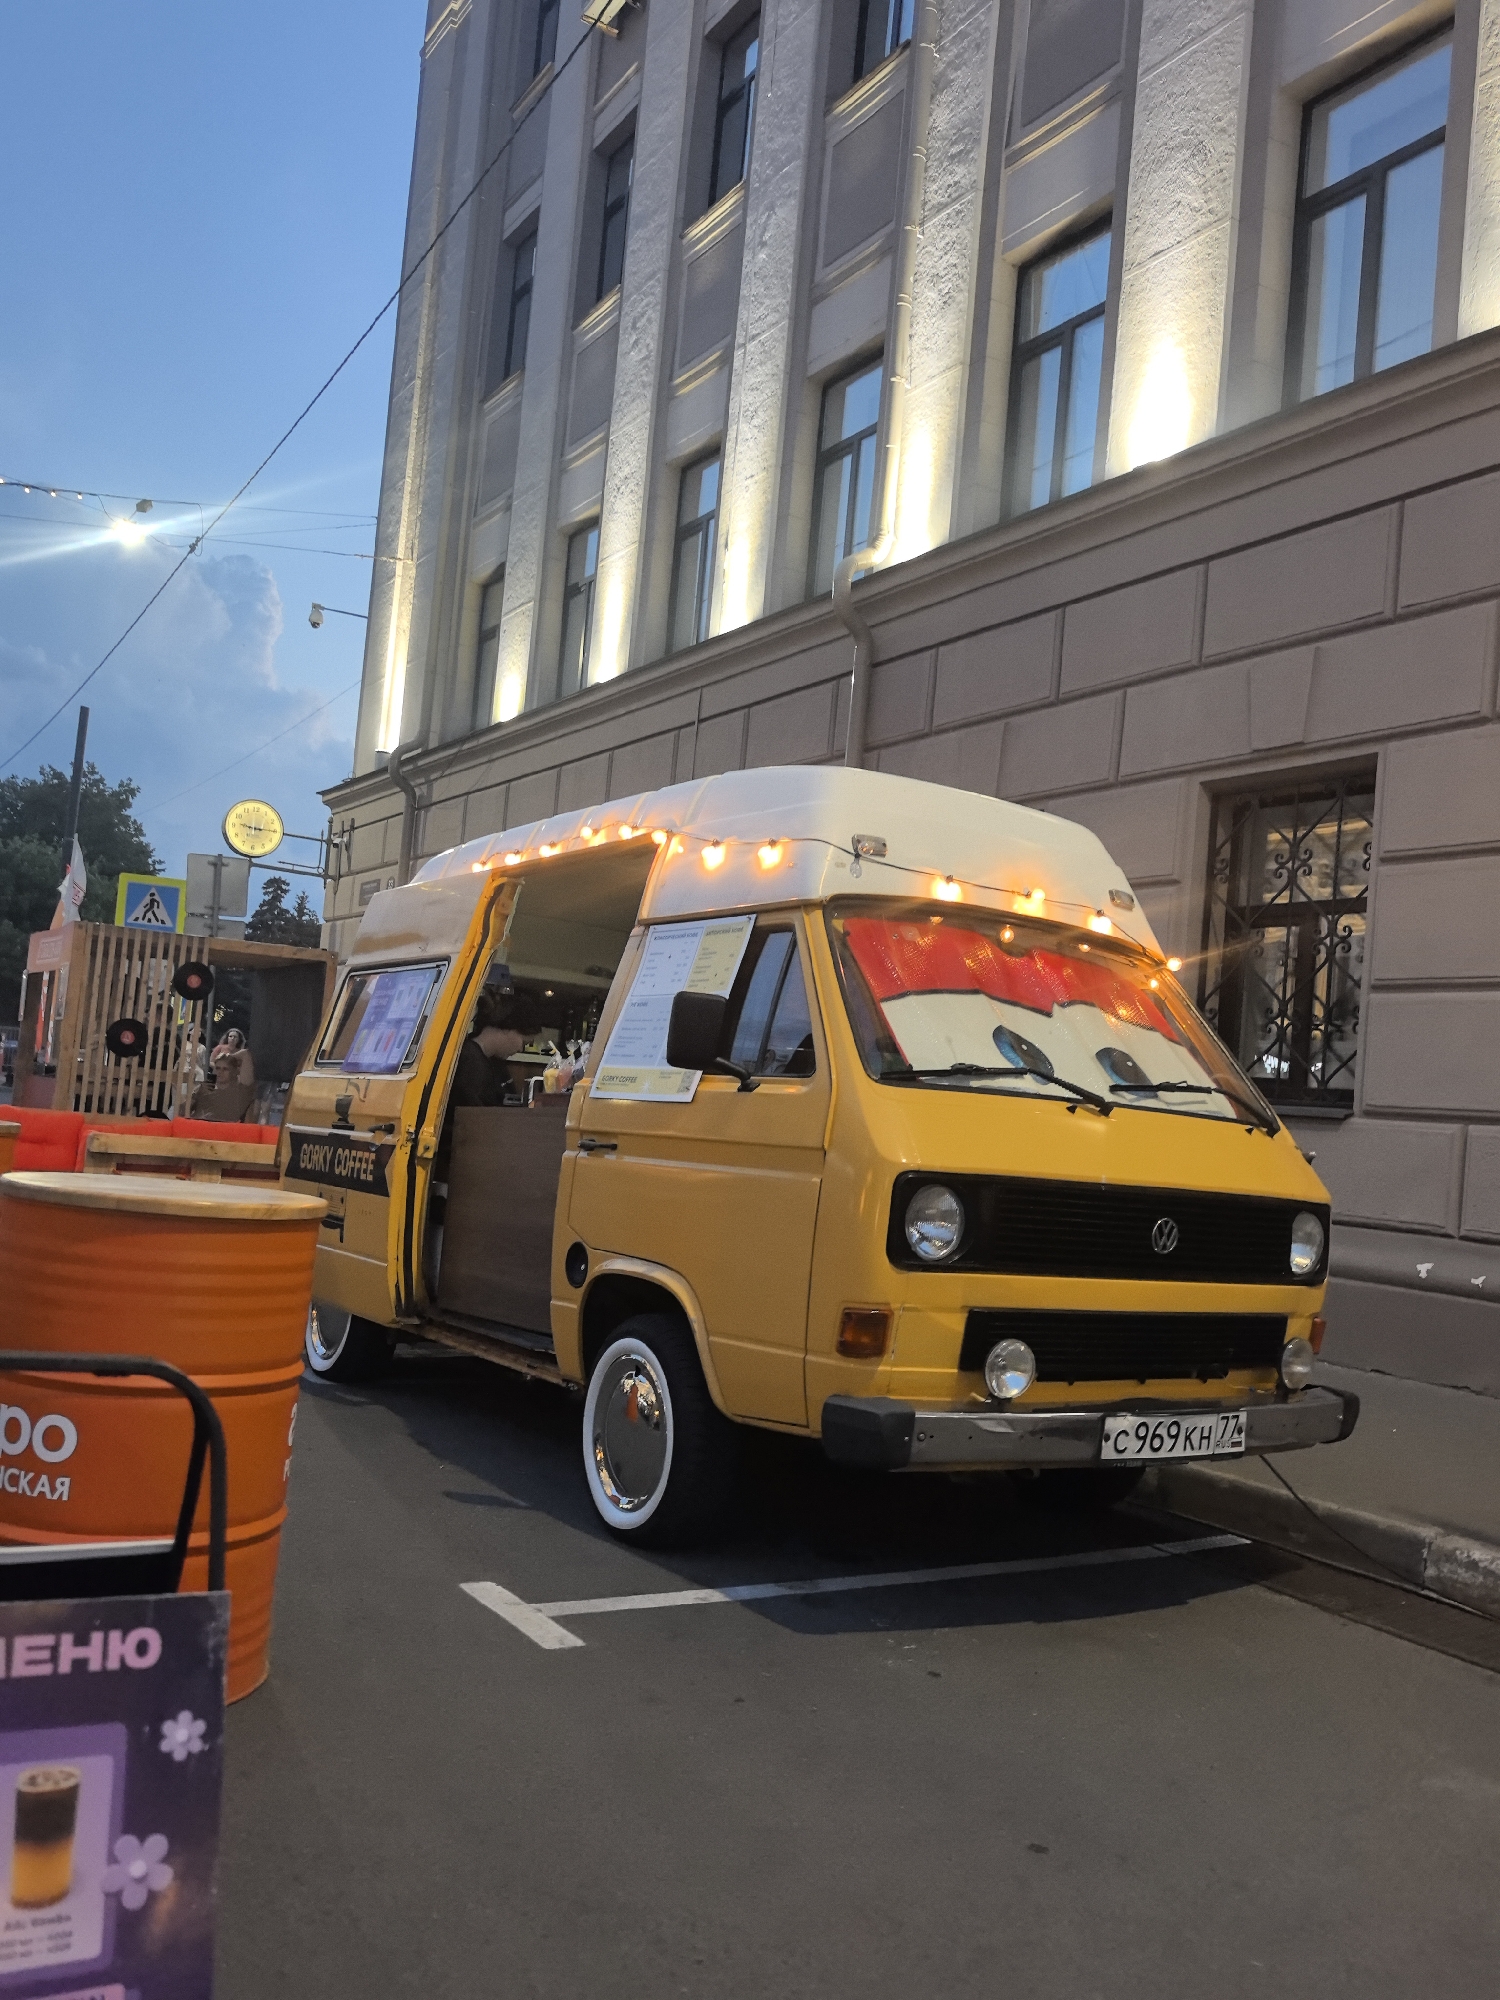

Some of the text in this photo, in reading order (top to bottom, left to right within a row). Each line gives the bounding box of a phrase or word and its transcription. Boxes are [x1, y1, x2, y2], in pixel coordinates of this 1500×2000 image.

[618, 1075, 638, 1083] COFFEE
[300, 1143, 376, 1181] GORKY COFFEE
[1220, 1414, 1241, 1441] 77
[0, 1626, 163, 1681] ЕНЮ
